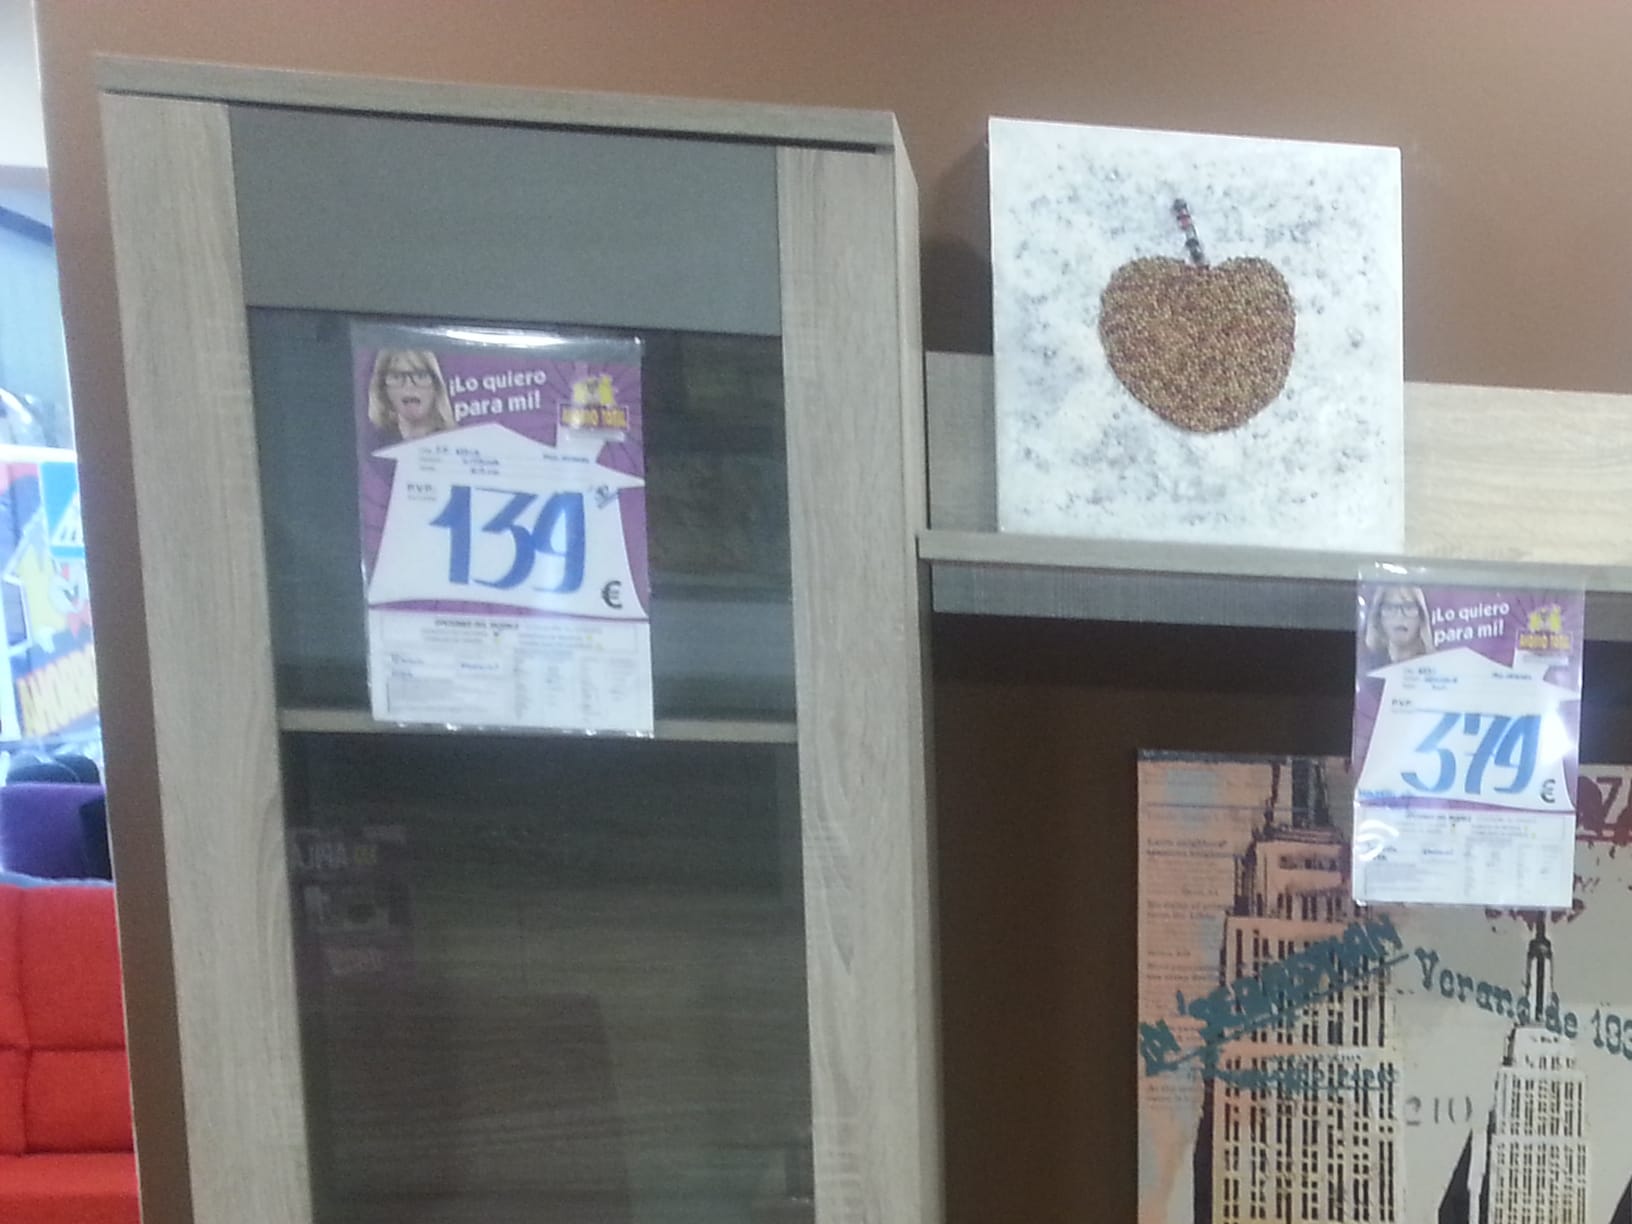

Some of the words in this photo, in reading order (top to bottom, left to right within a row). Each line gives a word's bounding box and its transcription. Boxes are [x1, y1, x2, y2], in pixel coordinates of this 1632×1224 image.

[483, 369, 547, 393] quiero
[454, 397, 503, 421] para
[430, 484, 586, 594] 139
[1459, 602, 1510, 622] quiero
[1434, 625, 1473, 647] para
[1401, 711, 1542, 795] 379
